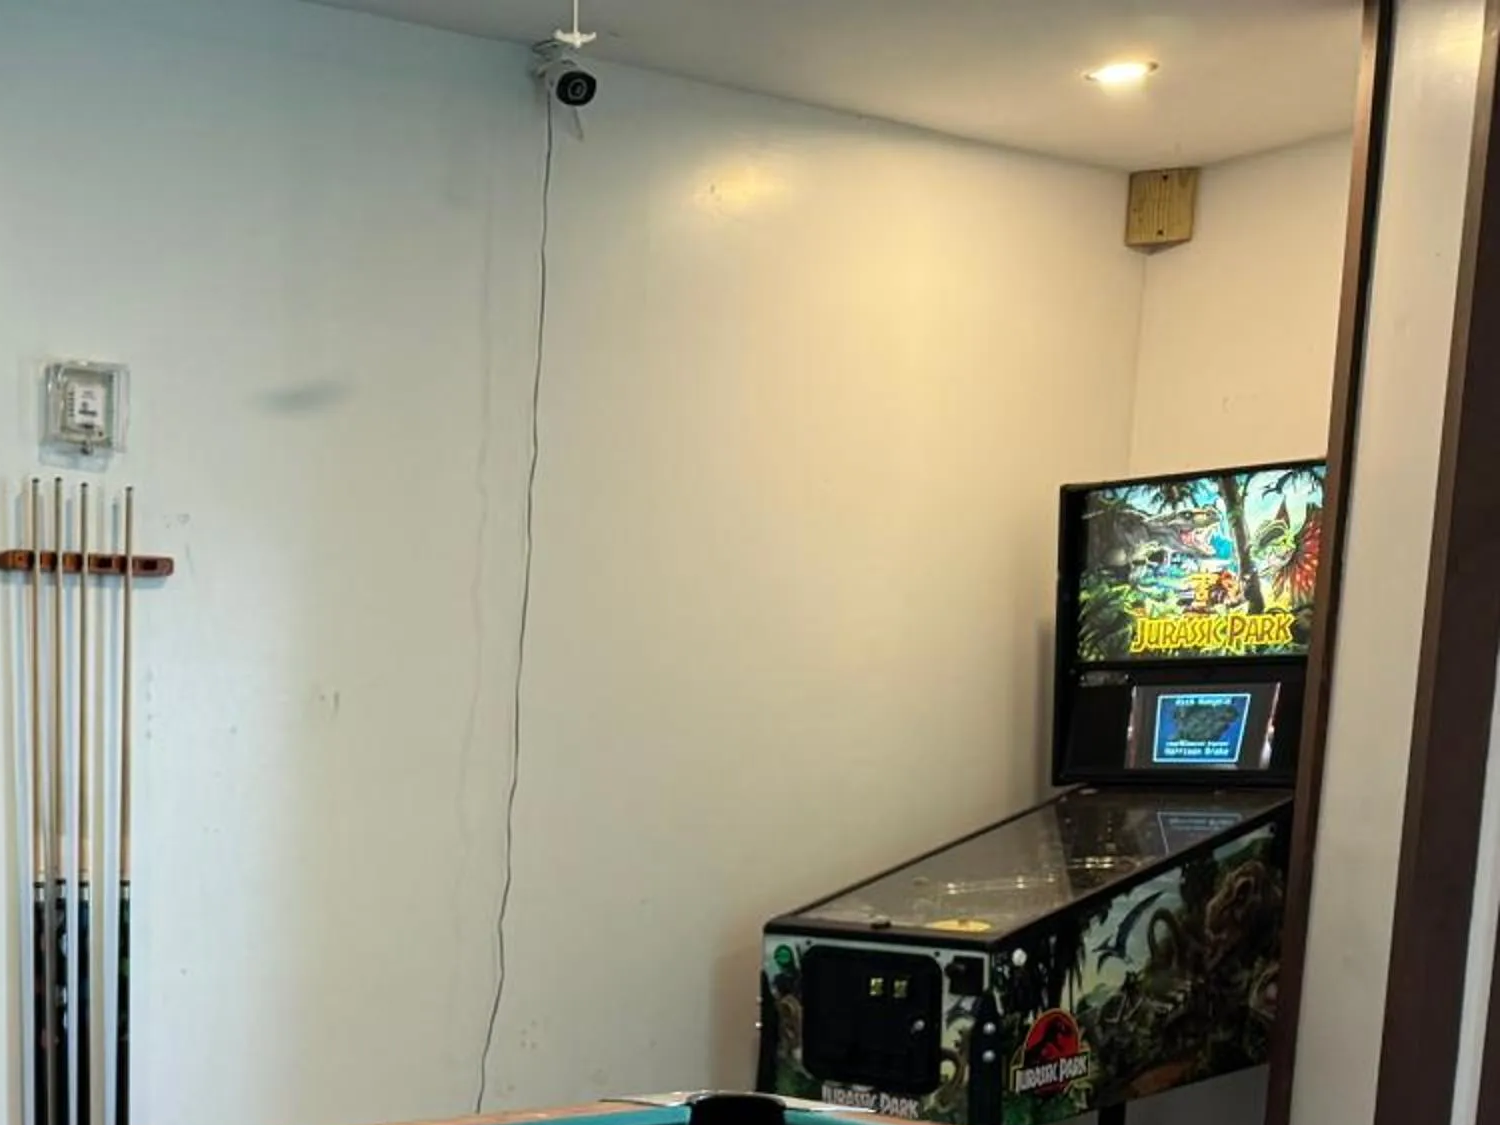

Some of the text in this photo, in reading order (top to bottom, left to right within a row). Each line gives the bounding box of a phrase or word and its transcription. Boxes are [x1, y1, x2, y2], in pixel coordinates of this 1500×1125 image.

[1131, 612, 1295, 652] JURASSIC PARK
[879, 1092, 920, 1119] PARK
